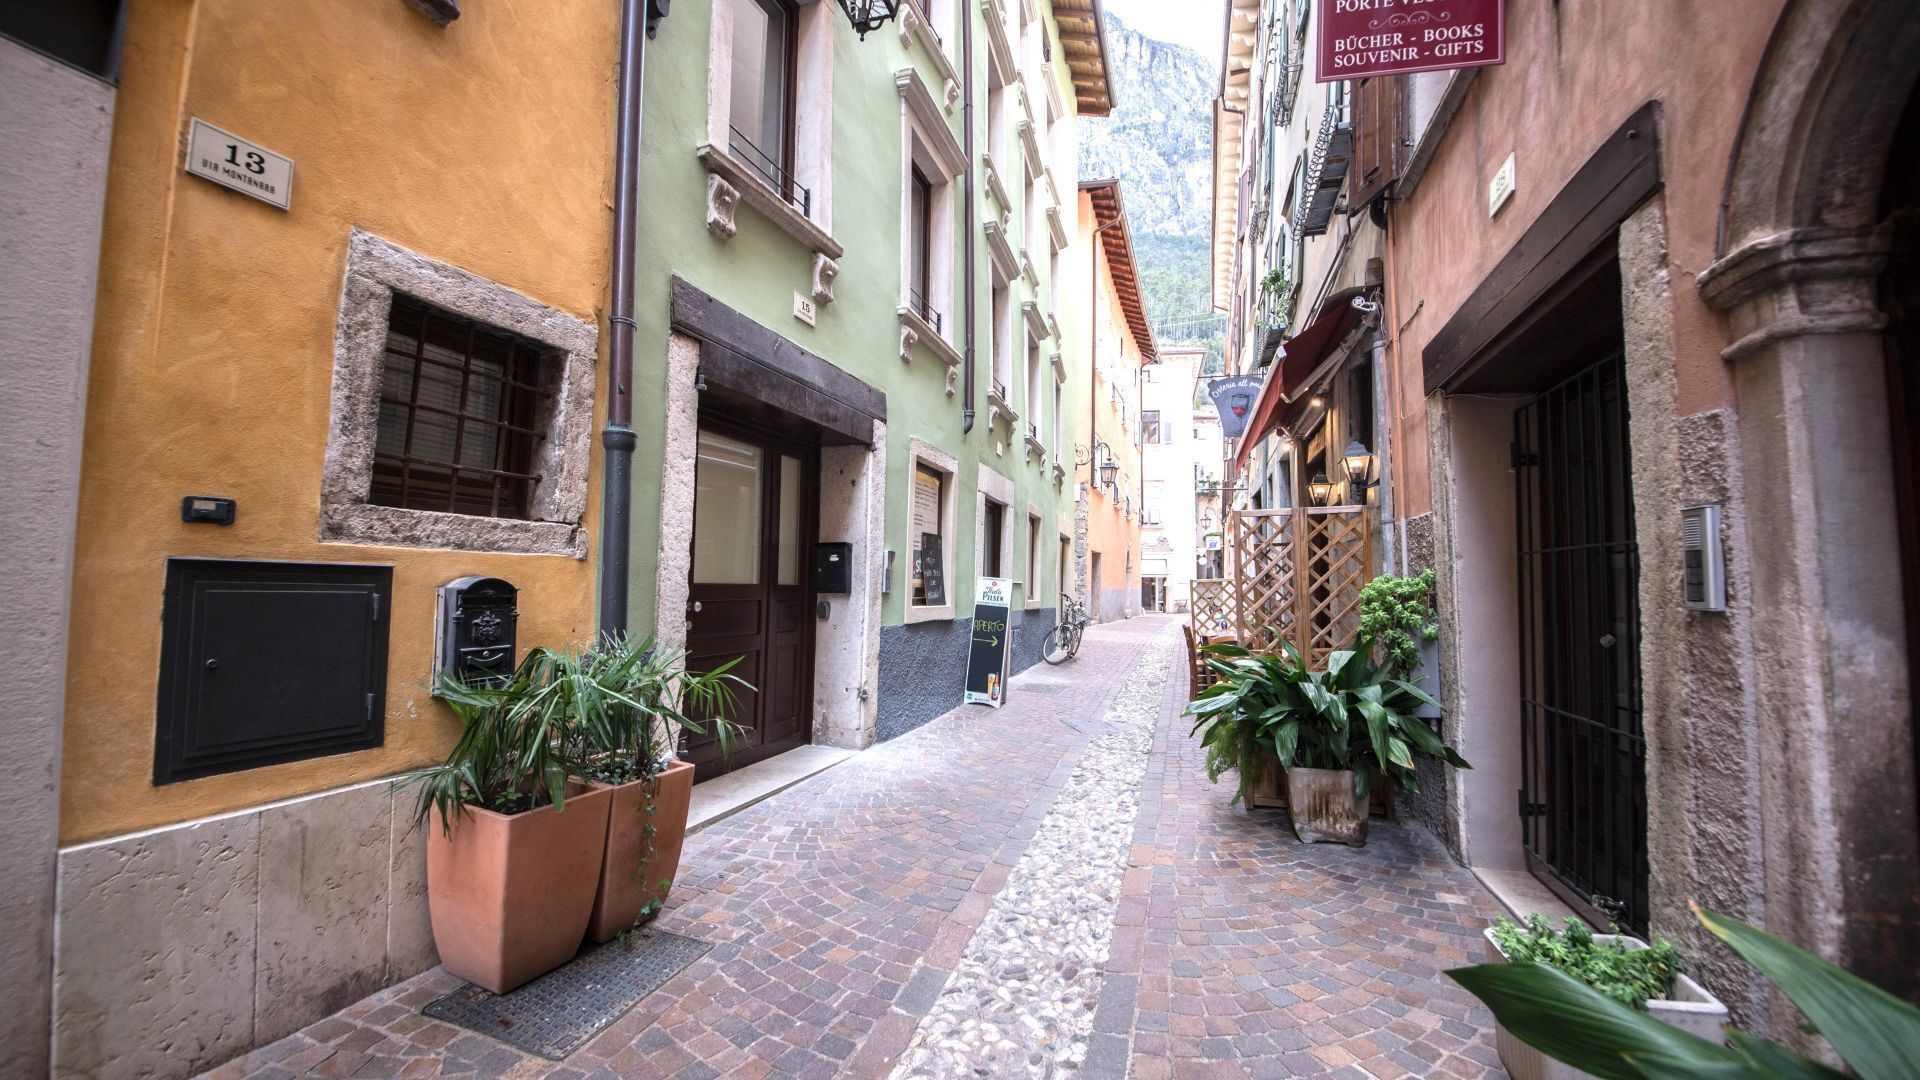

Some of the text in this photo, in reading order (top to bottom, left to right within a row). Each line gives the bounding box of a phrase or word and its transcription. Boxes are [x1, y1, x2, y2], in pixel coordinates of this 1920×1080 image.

[1335, 33, 1403, 52] BÜCHER
[1424, 24, 1484, 42] BOOKS
[1335, 47, 1419, 68] SOUVENIR
[1435, 40, 1484, 57] GIFTS
[225, 144, 265, 175] 13
[202, 158, 275, 194] VIA MONTANARA
[973, 619, 1005, 632] APERTO
